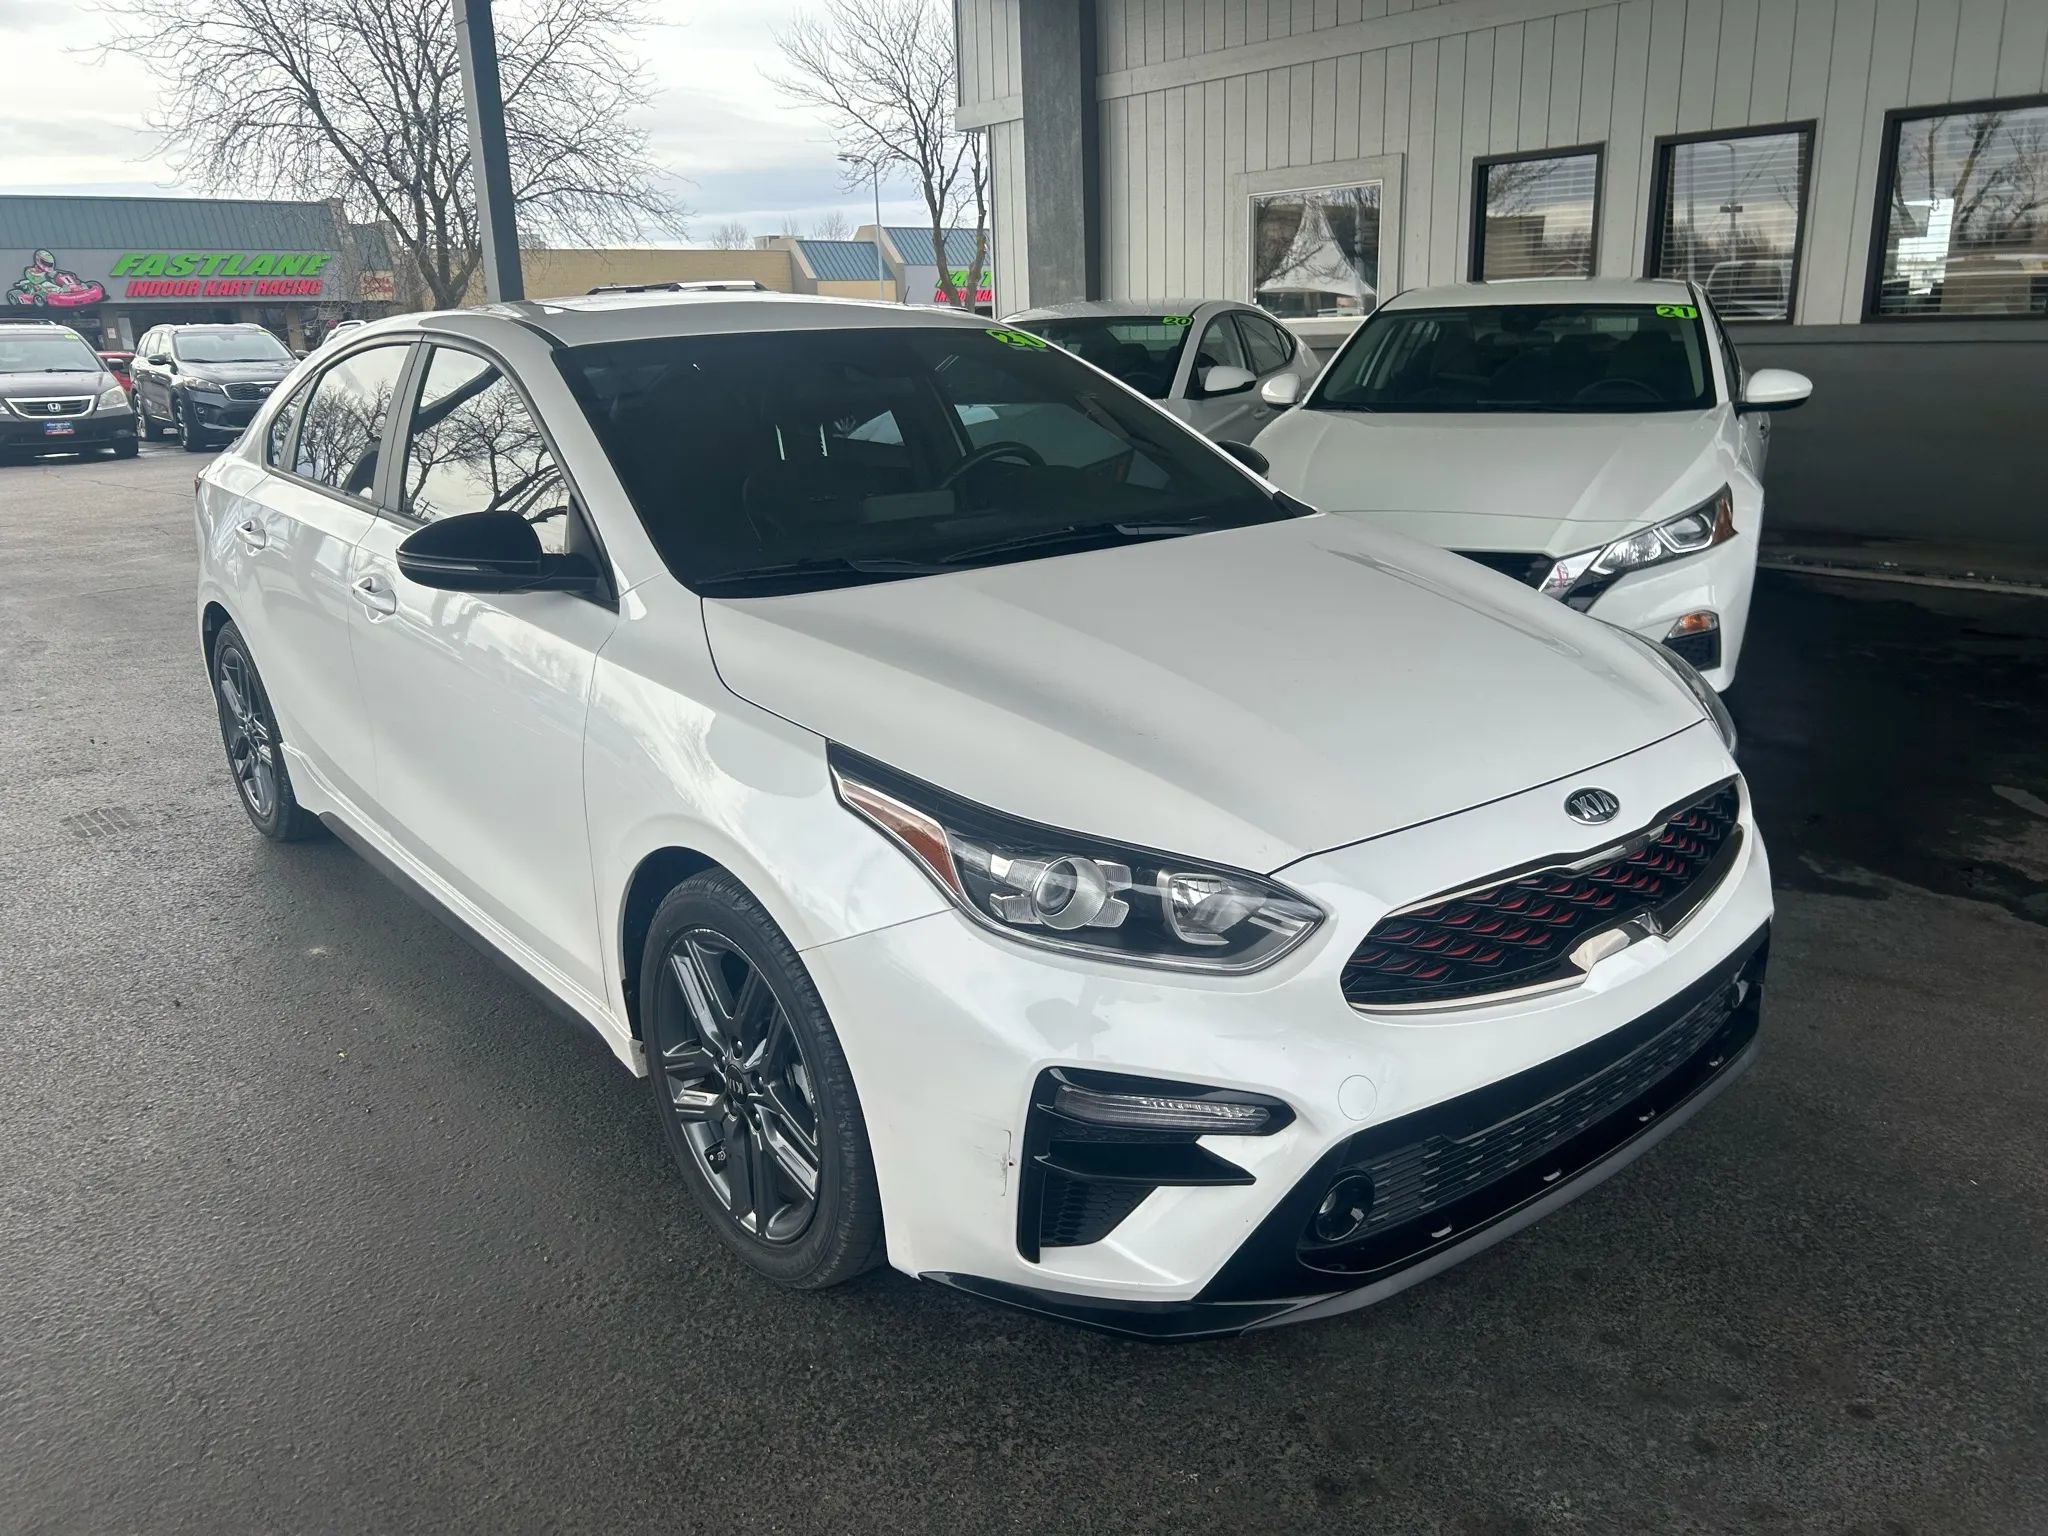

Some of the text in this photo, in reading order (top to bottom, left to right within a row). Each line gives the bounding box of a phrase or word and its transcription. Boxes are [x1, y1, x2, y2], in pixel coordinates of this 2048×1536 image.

[110, 253, 332, 278] FASTLANE
[126, 279, 322, 298] INDOOR KART RACING
[1164, 316, 1191, 325] 20
[1657, 305, 1695, 318] 21
[1571, 790, 1617, 820] KIA
